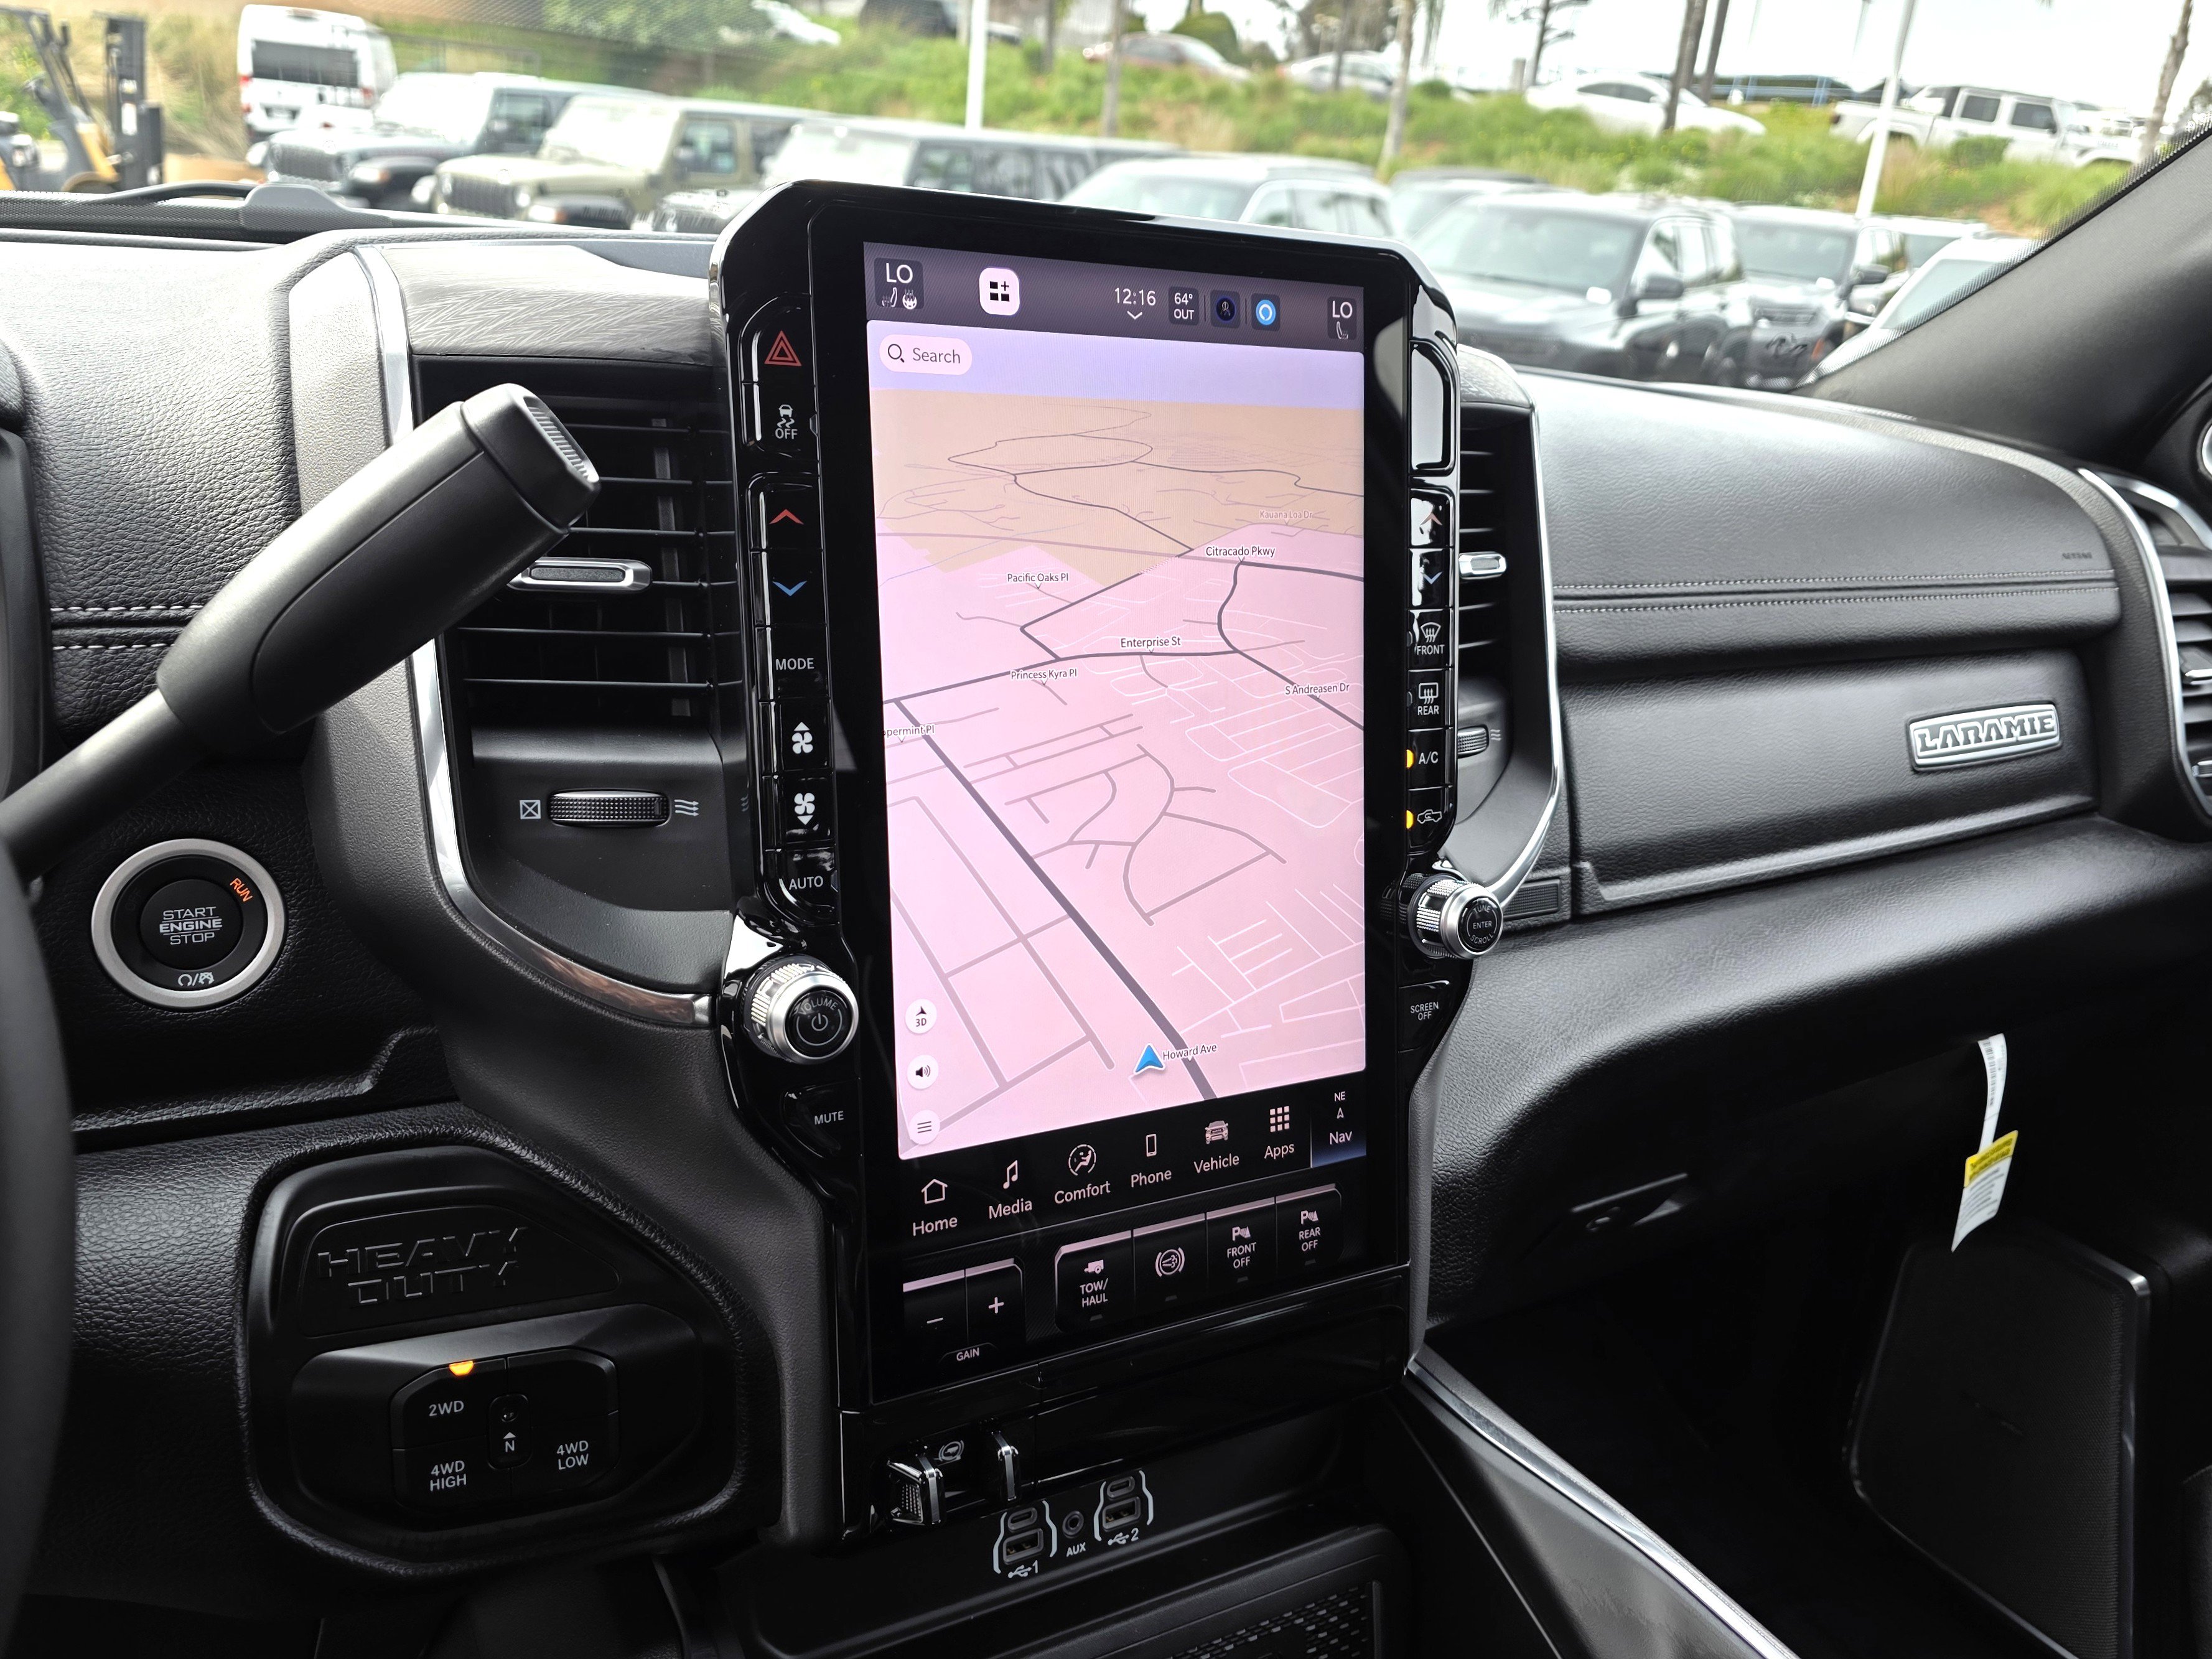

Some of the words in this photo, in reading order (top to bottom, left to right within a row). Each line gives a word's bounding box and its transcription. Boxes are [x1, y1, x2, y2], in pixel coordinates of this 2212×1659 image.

[886, 263, 913, 284] LO
[1114, 287, 1156, 306] 12:16
[1174, 309, 1194, 320] OUT
[1332, 301, 1353, 319] LO
[913, 347, 961, 363] Search
[775, 428, 798, 439] OFF
[1289, 510, 1302, 518] Loa
[1304, 510, 1312, 518] Dr
[1206, 546, 1249, 556] Citracado
[1252, 546, 1275, 557] Pkwy
[1007, 573, 1035, 582] Pacific
[1037, 573, 1058, 582] Oaks
[1061, 573, 1069, 581] Pl
[1121, 638, 1169, 648] Enterprise
[1172, 636, 1181, 646] St
[1417, 645, 1445, 655] FRONT
[775, 658, 814, 671] MODE
[1011, 670, 1047, 680] Princess
[1049, 670, 1067, 680] Kyra
[1070, 669, 1077, 677] Pl
[1285, 686, 1290, 694] S
[1292, 684, 1337, 694] Andreasen
[1340, 683, 1349, 692] Dr
[1417, 706, 1439, 716] REAR
[926, 725, 934, 734] Pl
[1916, 713, 2056, 753] LARAMIE
[1419, 751, 1439, 765] A/C
[230, 877, 253, 902] RUN
[789, 876, 823, 890] AUTO
[162, 906, 217, 920] START
[1473, 904, 1491, 914] TUNE
[159, 918, 223, 933] ENGINE
[1473, 920, 1492, 929] ENTER
[170, 932, 215, 945] STOP
[1470, 933, 1493, 945] SCROLL
[799, 997, 839, 1015] VOLUME
[1410, 1001, 1439, 1014] SCREEN
[915, 1017, 927, 1027] 3D
[1417, 1011, 1432, 1021] OFF
[1163, 1045, 1198, 1060] Howard
[1200, 1045, 1216, 1054] Ave
[1334, 1091, 1346, 1102] NE
[814, 1111, 844, 1125] MUTE
[1330, 1131, 1352, 1145] Nav
[1264, 1143, 1295, 1159] Apps
[1193, 1153, 1239, 1174] Vehicle
[1131, 1169, 1172, 1187] Phone
[1055, 1181, 1111, 1204] Comfort
[989, 1199, 1032, 1219] Media
[912, 1217, 958, 1236] Home
[1299, 1227, 1321, 1240] REAR
[317, 1227, 528, 1279] HEAVY
[1227, 1242, 1257, 1258] FRONT
[1301, 1240, 1318, 1252] OFF
[1233, 1256, 1251, 1269] OFF
[346, 1259, 520, 1306] DUTY
[1080, 1278, 1108, 1295] TOW/
[1082, 1293, 1108, 1309] HAUL
[956, 1347, 980, 1362] GAIN
[428, 1400, 464, 1417] 2WD
[505, 1439, 515, 1452] N
[556, 1439, 589, 1456] 4WD
[558, 1453, 589, 1470] LOW
[431, 1460, 465, 1478] 4WD
[429, 1474, 467, 1492] HIGH
[1131, 1528, 1139, 1541] 2
[1066, 1542, 1086, 1558] AUX
[1032, 1561, 1038, 1574] 1
